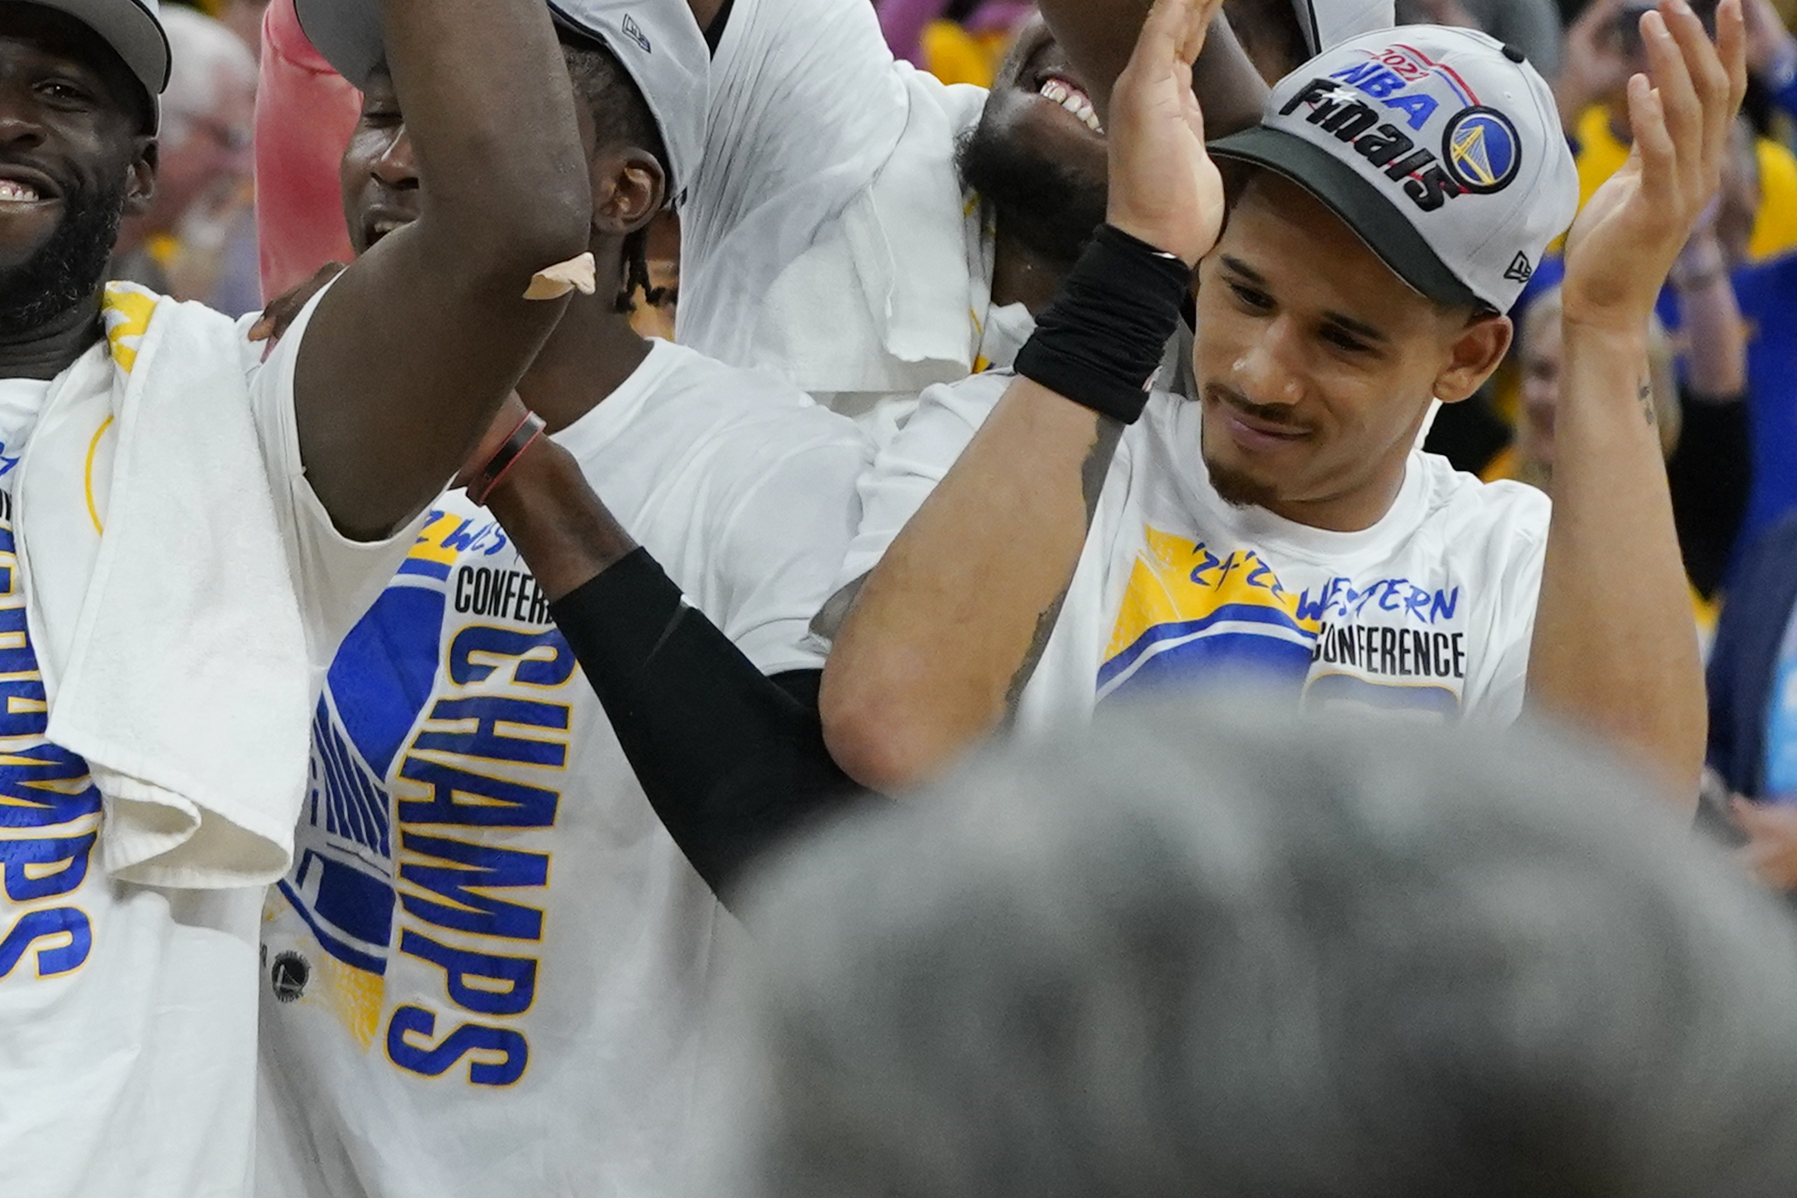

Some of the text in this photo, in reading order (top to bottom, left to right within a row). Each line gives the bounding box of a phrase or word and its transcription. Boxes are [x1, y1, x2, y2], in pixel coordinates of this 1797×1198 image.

[1371, 48, 1429, 82] 2022
[1329, 61, 1440, 132] NBA
[1278, 77, 1461, 213] Finals
[454, 565, 553, 625] CONFER
[1295, 576, 1459, 625] WESTERN
[1311, 620, 1466, 679] CONFERENCE
[384, 622, 582, 1088] CHAMPS
